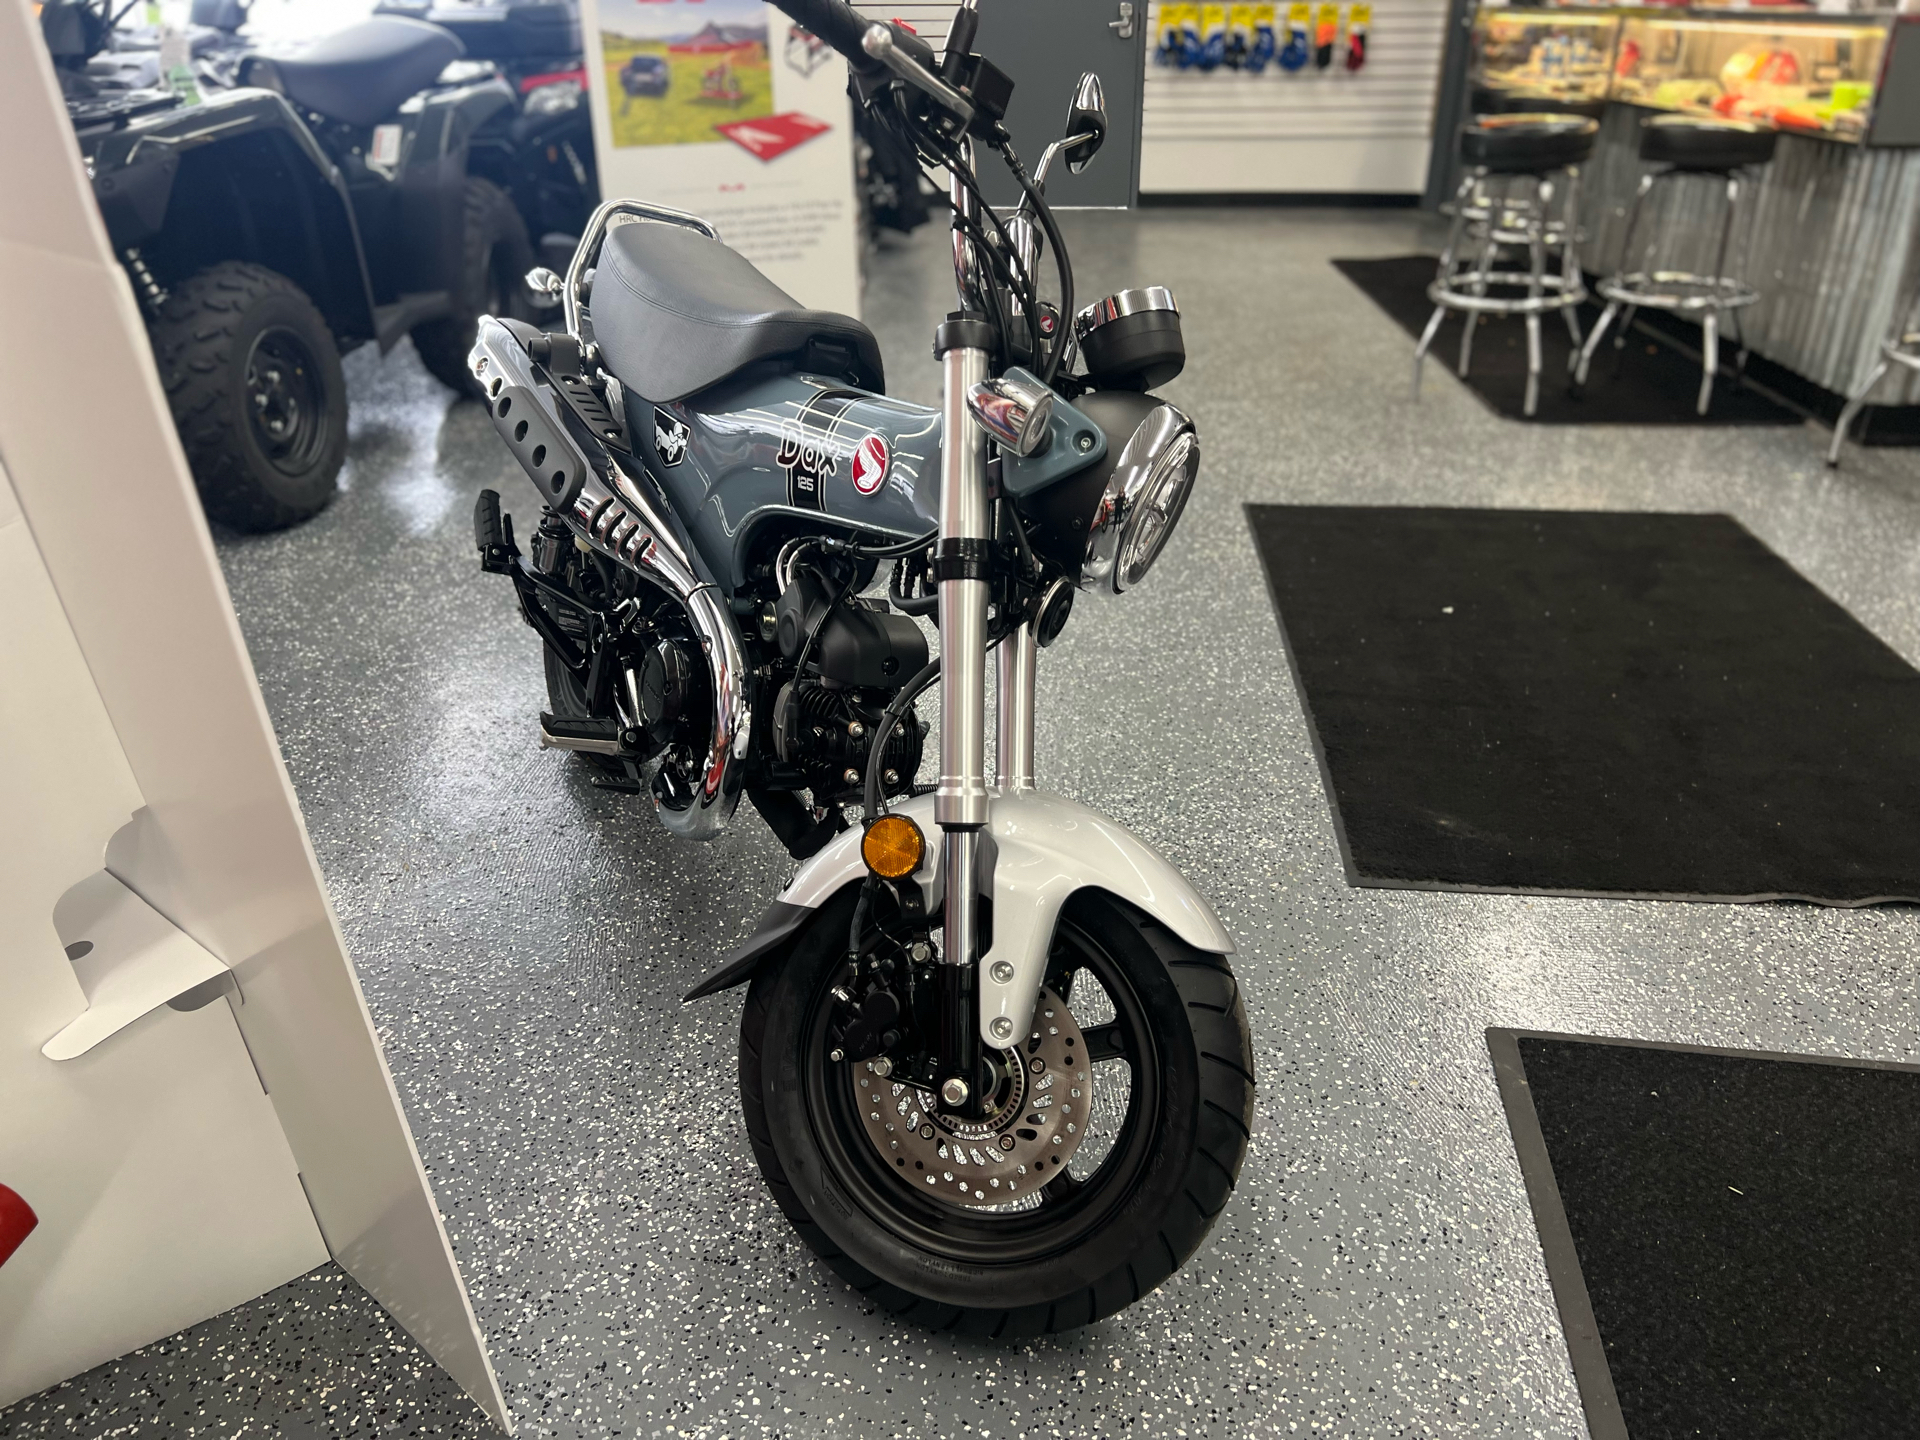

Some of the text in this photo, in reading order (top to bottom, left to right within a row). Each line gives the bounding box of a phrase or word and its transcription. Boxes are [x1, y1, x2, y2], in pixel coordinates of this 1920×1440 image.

[619, 215, 637, 223] HRC
[776, 418, 840, 477] Dax
[797, 475, 814, 492] 125
